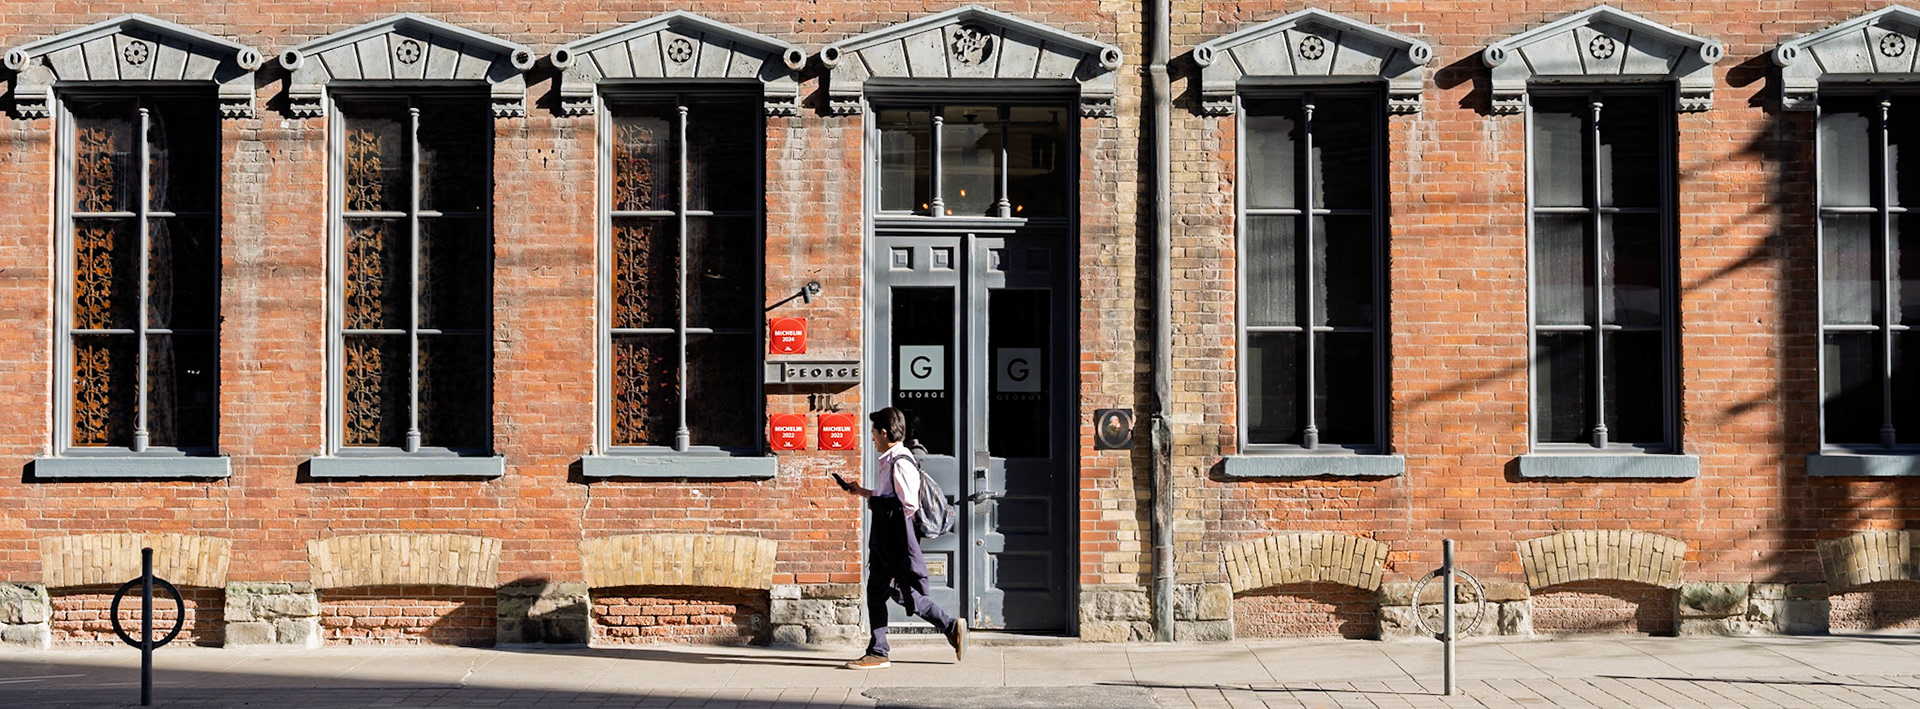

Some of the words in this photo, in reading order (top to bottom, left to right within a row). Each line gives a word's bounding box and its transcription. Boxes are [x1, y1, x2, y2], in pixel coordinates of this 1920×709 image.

[786, 367, 859, 378] GEORGE
[910, 355, 932, 379] G
[1007, 358, 1030, 382] G
[899, 391, 945, 399] GEORGE
